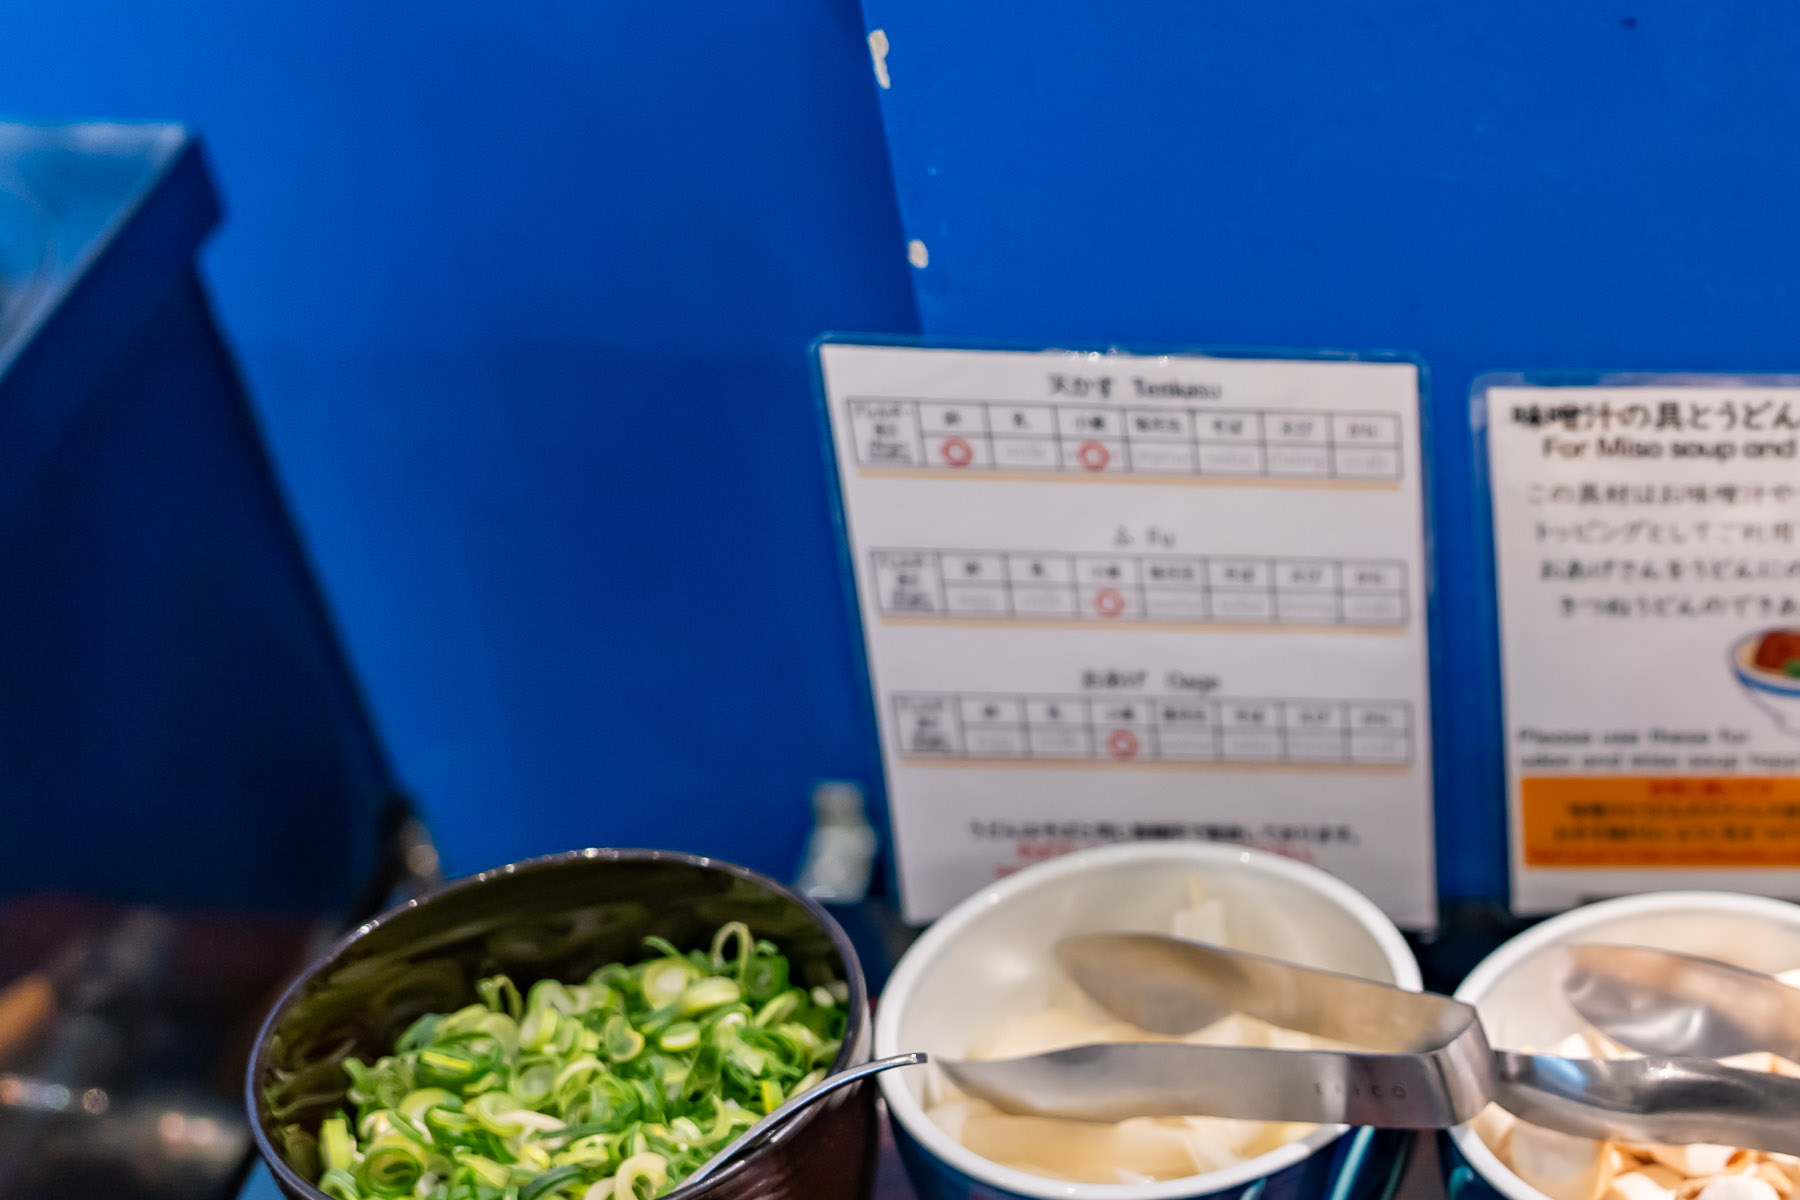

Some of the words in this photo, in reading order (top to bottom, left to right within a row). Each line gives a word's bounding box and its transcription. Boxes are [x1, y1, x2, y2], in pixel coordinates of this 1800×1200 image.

[1542, 437, 1588, 459] For
[1597, 437, 1664, 458] Miso
[1672, 442, 1739, 463] soup
[1742, 438, 1797, 459] and
